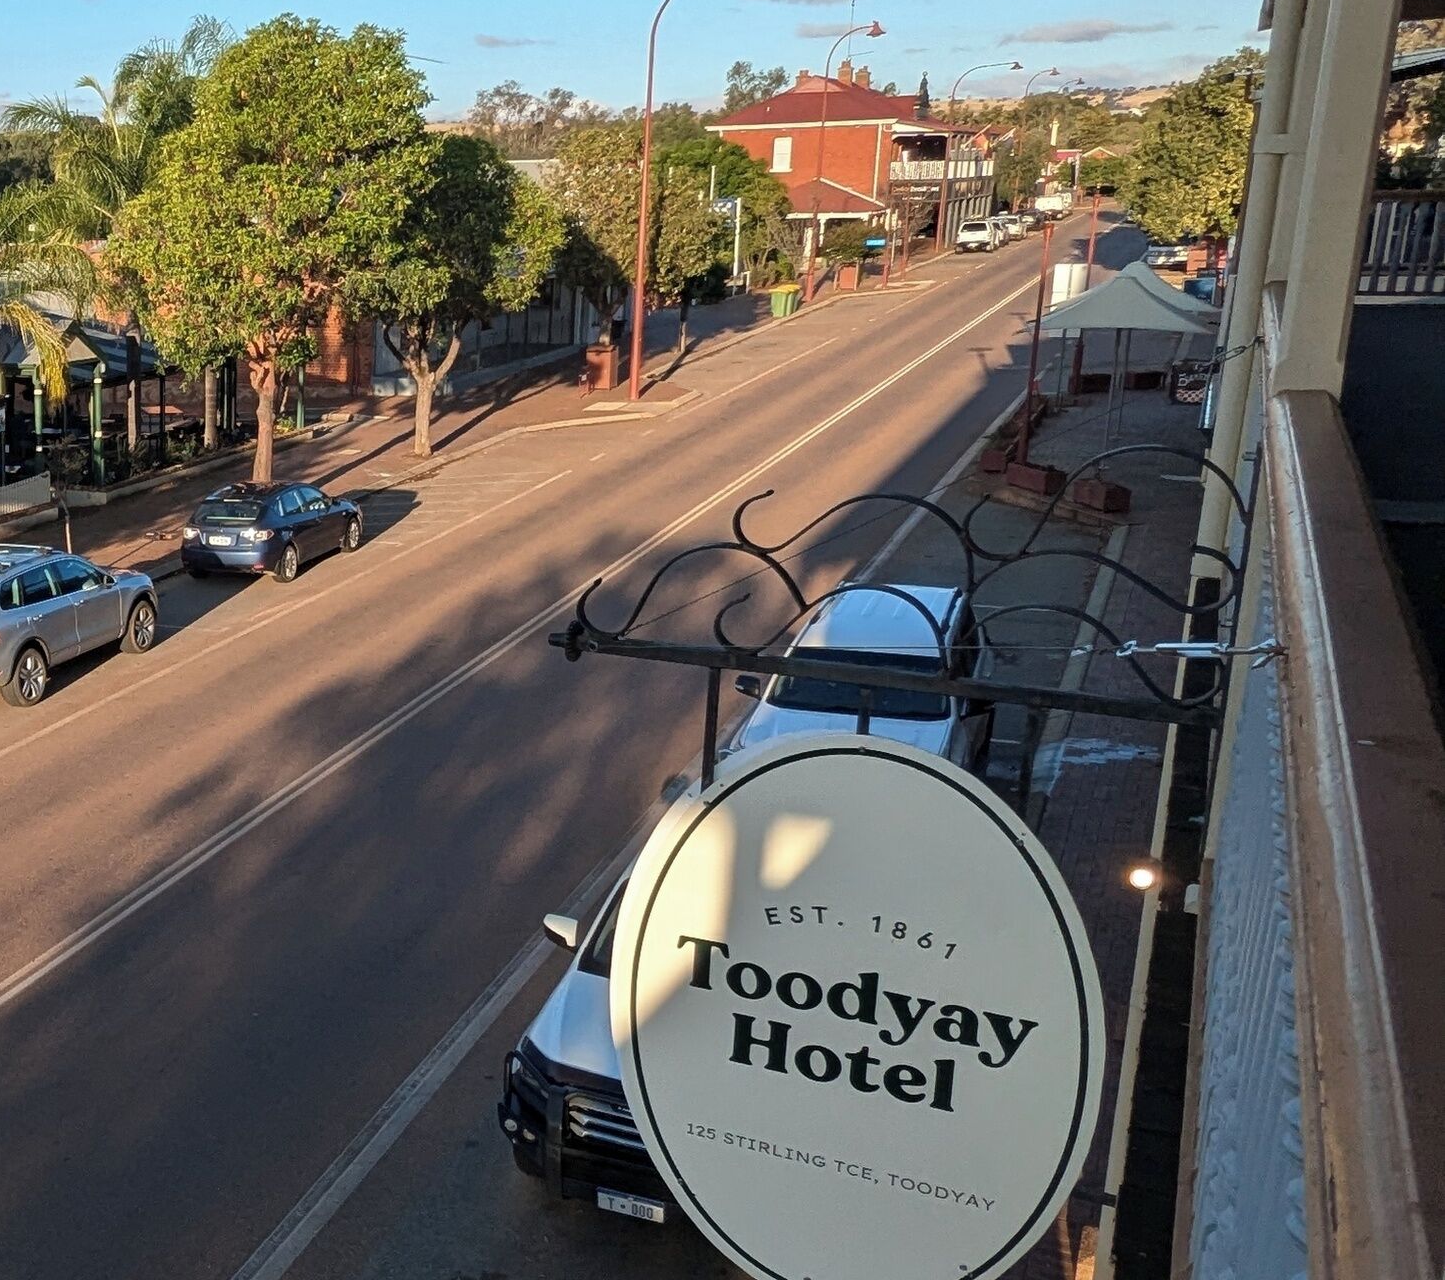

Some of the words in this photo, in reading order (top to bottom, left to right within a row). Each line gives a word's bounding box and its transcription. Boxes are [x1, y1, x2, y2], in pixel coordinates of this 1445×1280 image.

[764, 905, 844, 926] EST.
[872, 915, 957, 960] 1861
[676, 934, 1039, 1069] Toodyay
[728, 1012, 956, 1112] Hotel
[686, 1122, 717, 1141] 125
[723, 1131, 827, 1169] STIRLING
[833, 1159, 880, 1185] TCE,
[887, 1172, 996, 1212] TOODYAY
